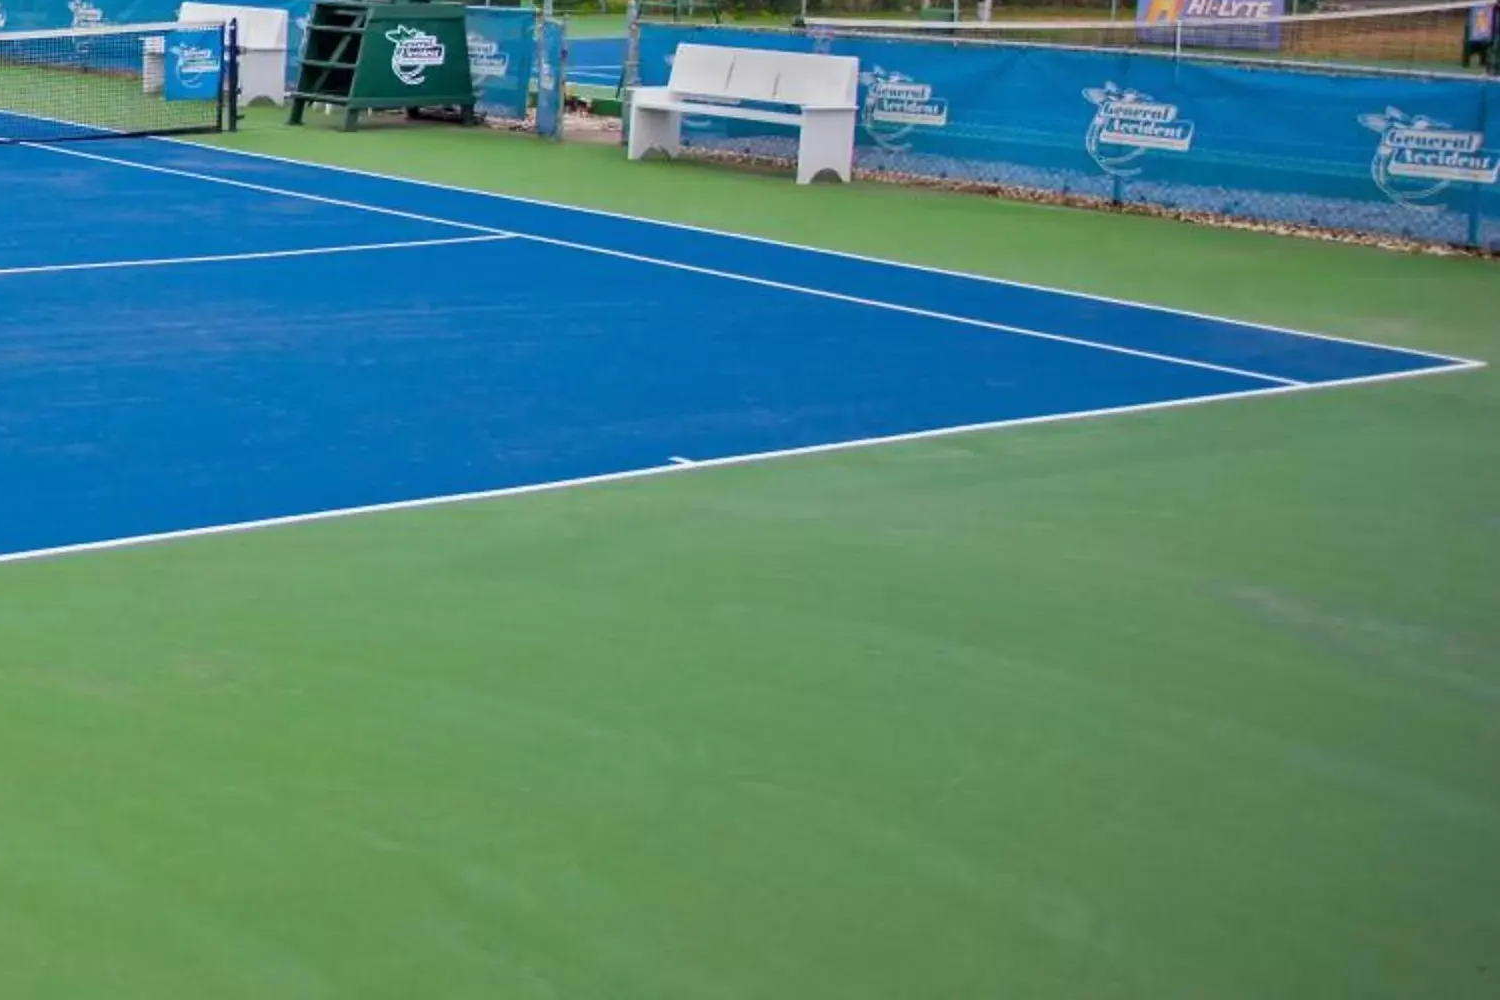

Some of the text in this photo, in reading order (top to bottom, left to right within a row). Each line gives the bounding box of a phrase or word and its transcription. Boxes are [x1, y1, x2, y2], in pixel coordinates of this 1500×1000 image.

[879, 99, 939, 114] Accident
[1104, 101, 1169, 119] General
[1107, 117, 1183, 138] Accident
[1388, 131, 1474, 150] General
[1393, 147, 1490, 169] Accident
